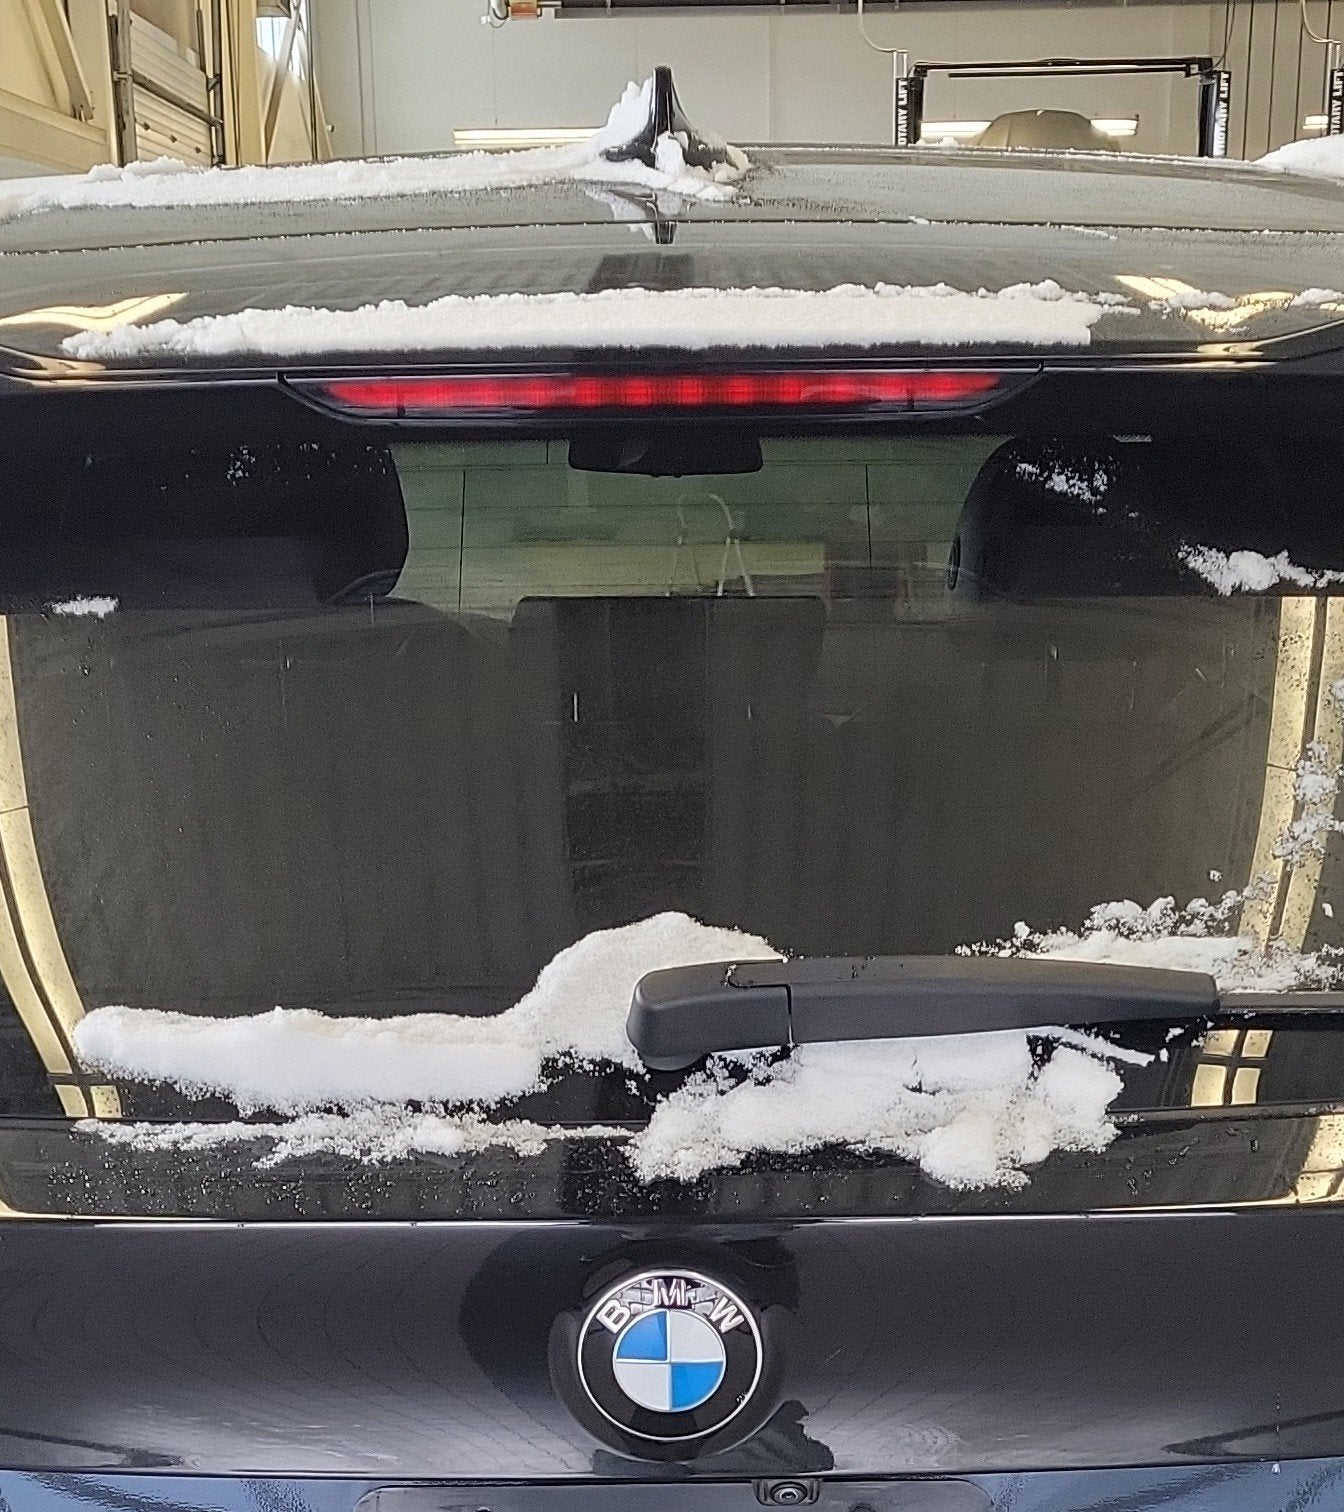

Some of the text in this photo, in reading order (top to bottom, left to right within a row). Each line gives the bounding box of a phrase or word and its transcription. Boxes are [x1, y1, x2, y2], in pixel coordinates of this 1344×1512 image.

[1219, 71, 1230, 98] LIFT
[1332, 70, 1344, 97] LIFT
[897, 79, 908, 146] OTARY LIFT
[596, 1278, 745, 1335] BMW
